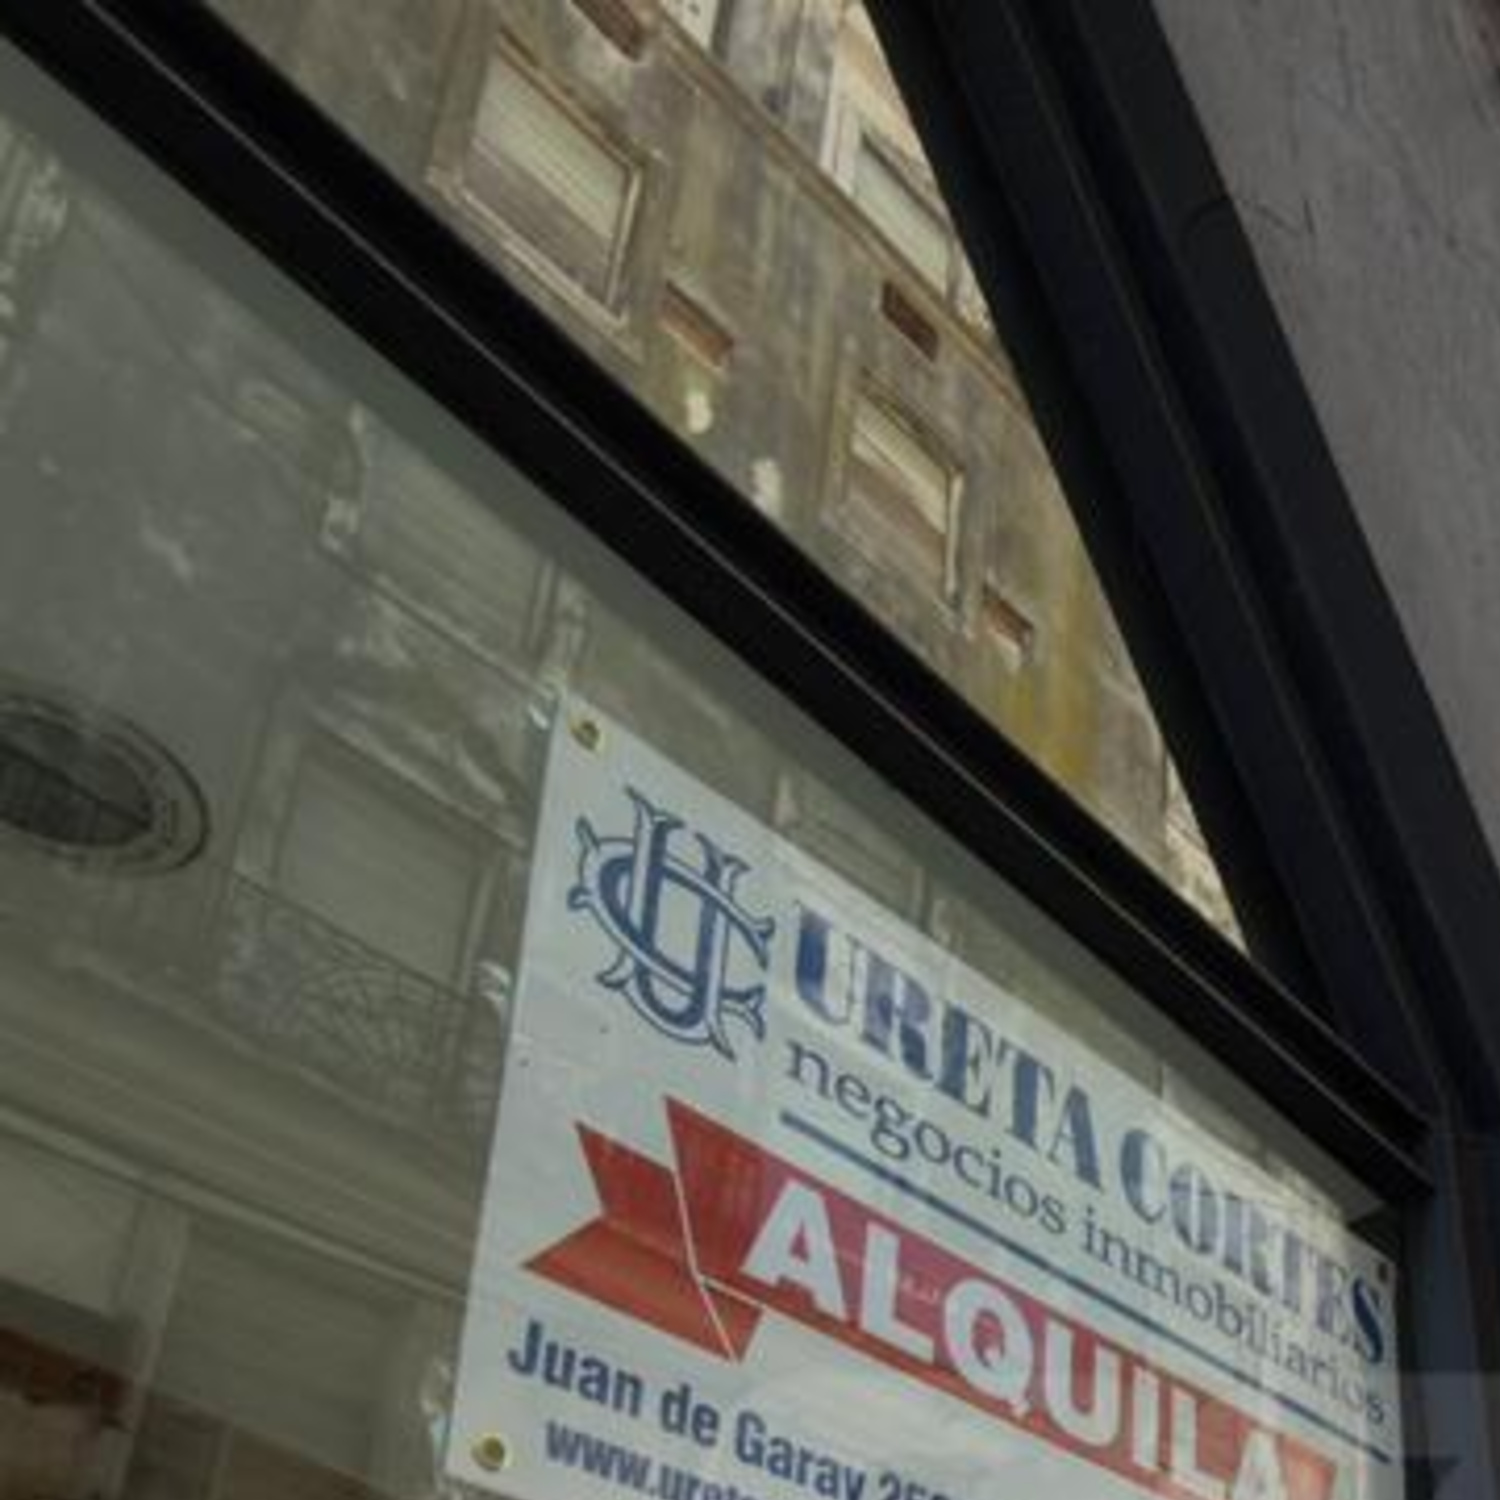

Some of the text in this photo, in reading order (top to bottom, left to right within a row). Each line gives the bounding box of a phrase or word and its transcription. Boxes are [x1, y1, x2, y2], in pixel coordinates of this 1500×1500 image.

[786, 1037, 1386, 1426] negocios inmobiliarios
[793, 898, 1384, 1366] URETA CORTES
[507, 1319, 645, 1419] Juan
[660, 1382, 719, 1447] de
